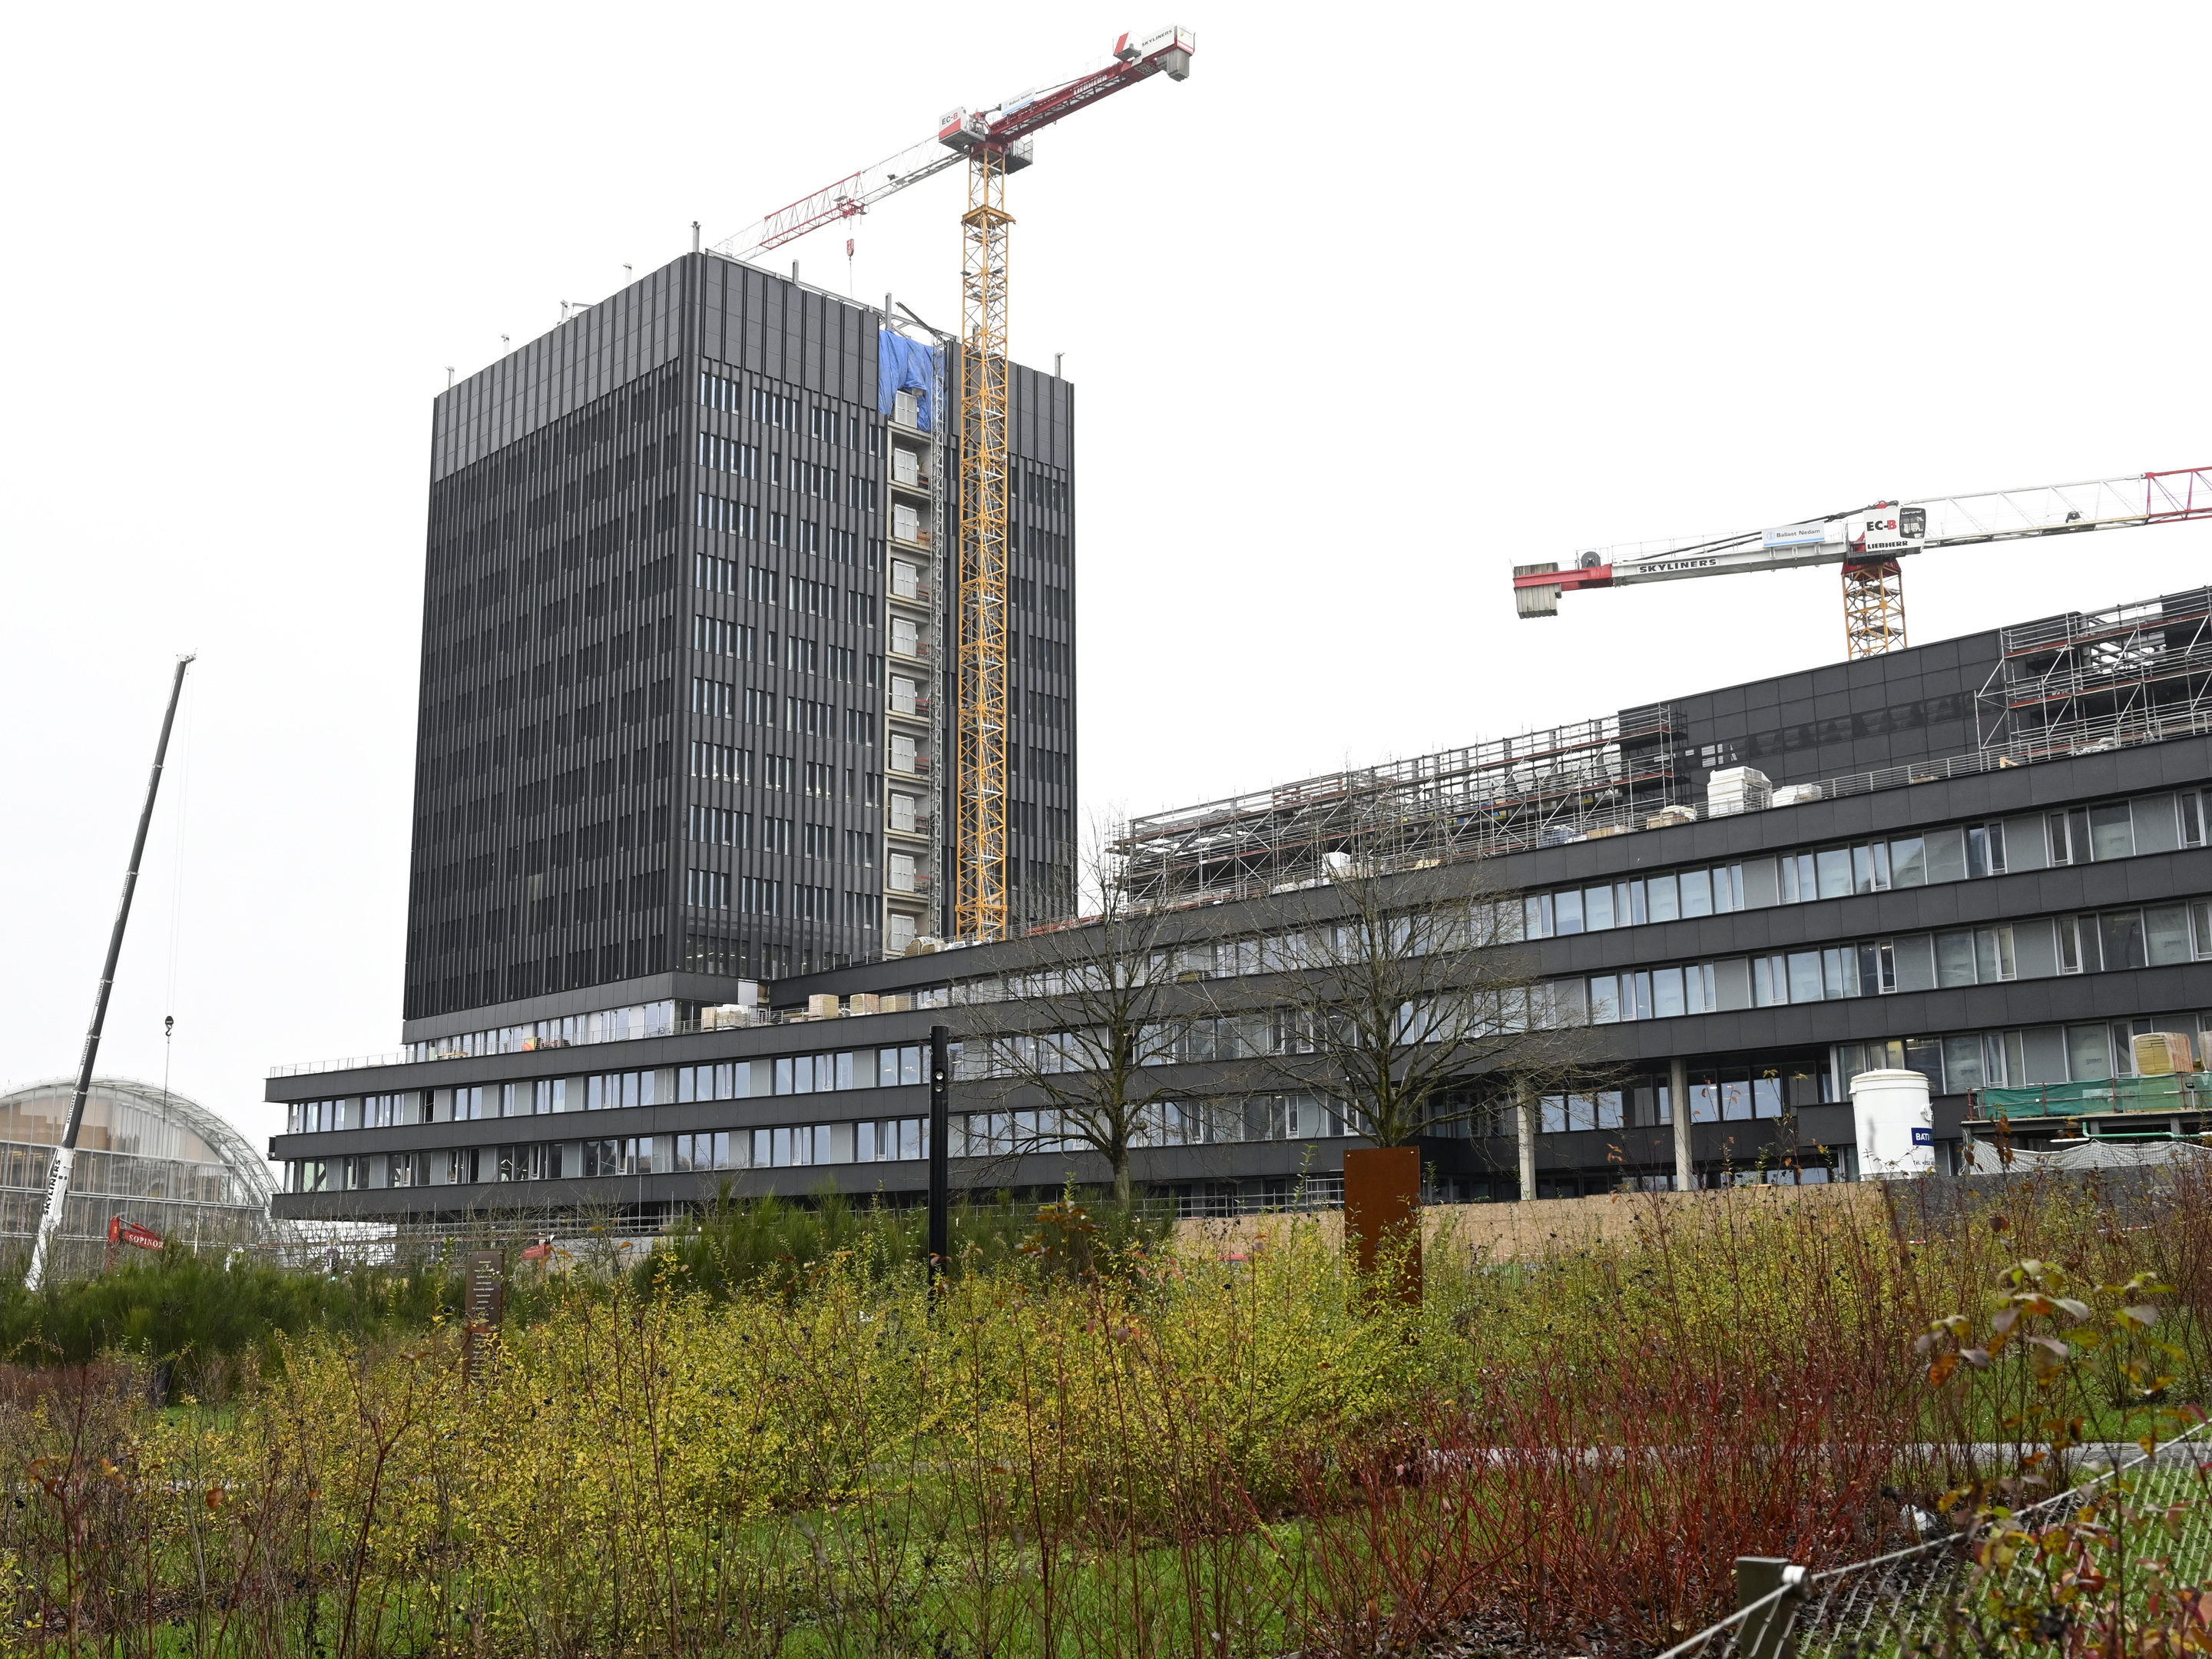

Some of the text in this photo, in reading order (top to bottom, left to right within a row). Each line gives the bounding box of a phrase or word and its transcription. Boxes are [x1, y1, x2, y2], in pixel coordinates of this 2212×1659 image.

[1141, 28, 1172, 47] SKYLINERS
[1073, 75, 1108, 95] LIEBHERR
[942, 112, 959, 126] EC-B
[1866, 519, 1897, 531] EC-B
[1867, 541, 1908, 549] LIEBHERR
[1639, 558, 1717, 573] SKYLINERS
[81, 1038, 90, 1066] SKYLINERS
[66, 1093, 76, 1124] SKYLINERS
[43, 1159, 61, 1216] SKYLINERS
[128, 1234, 164, 1249] SOPINOR
